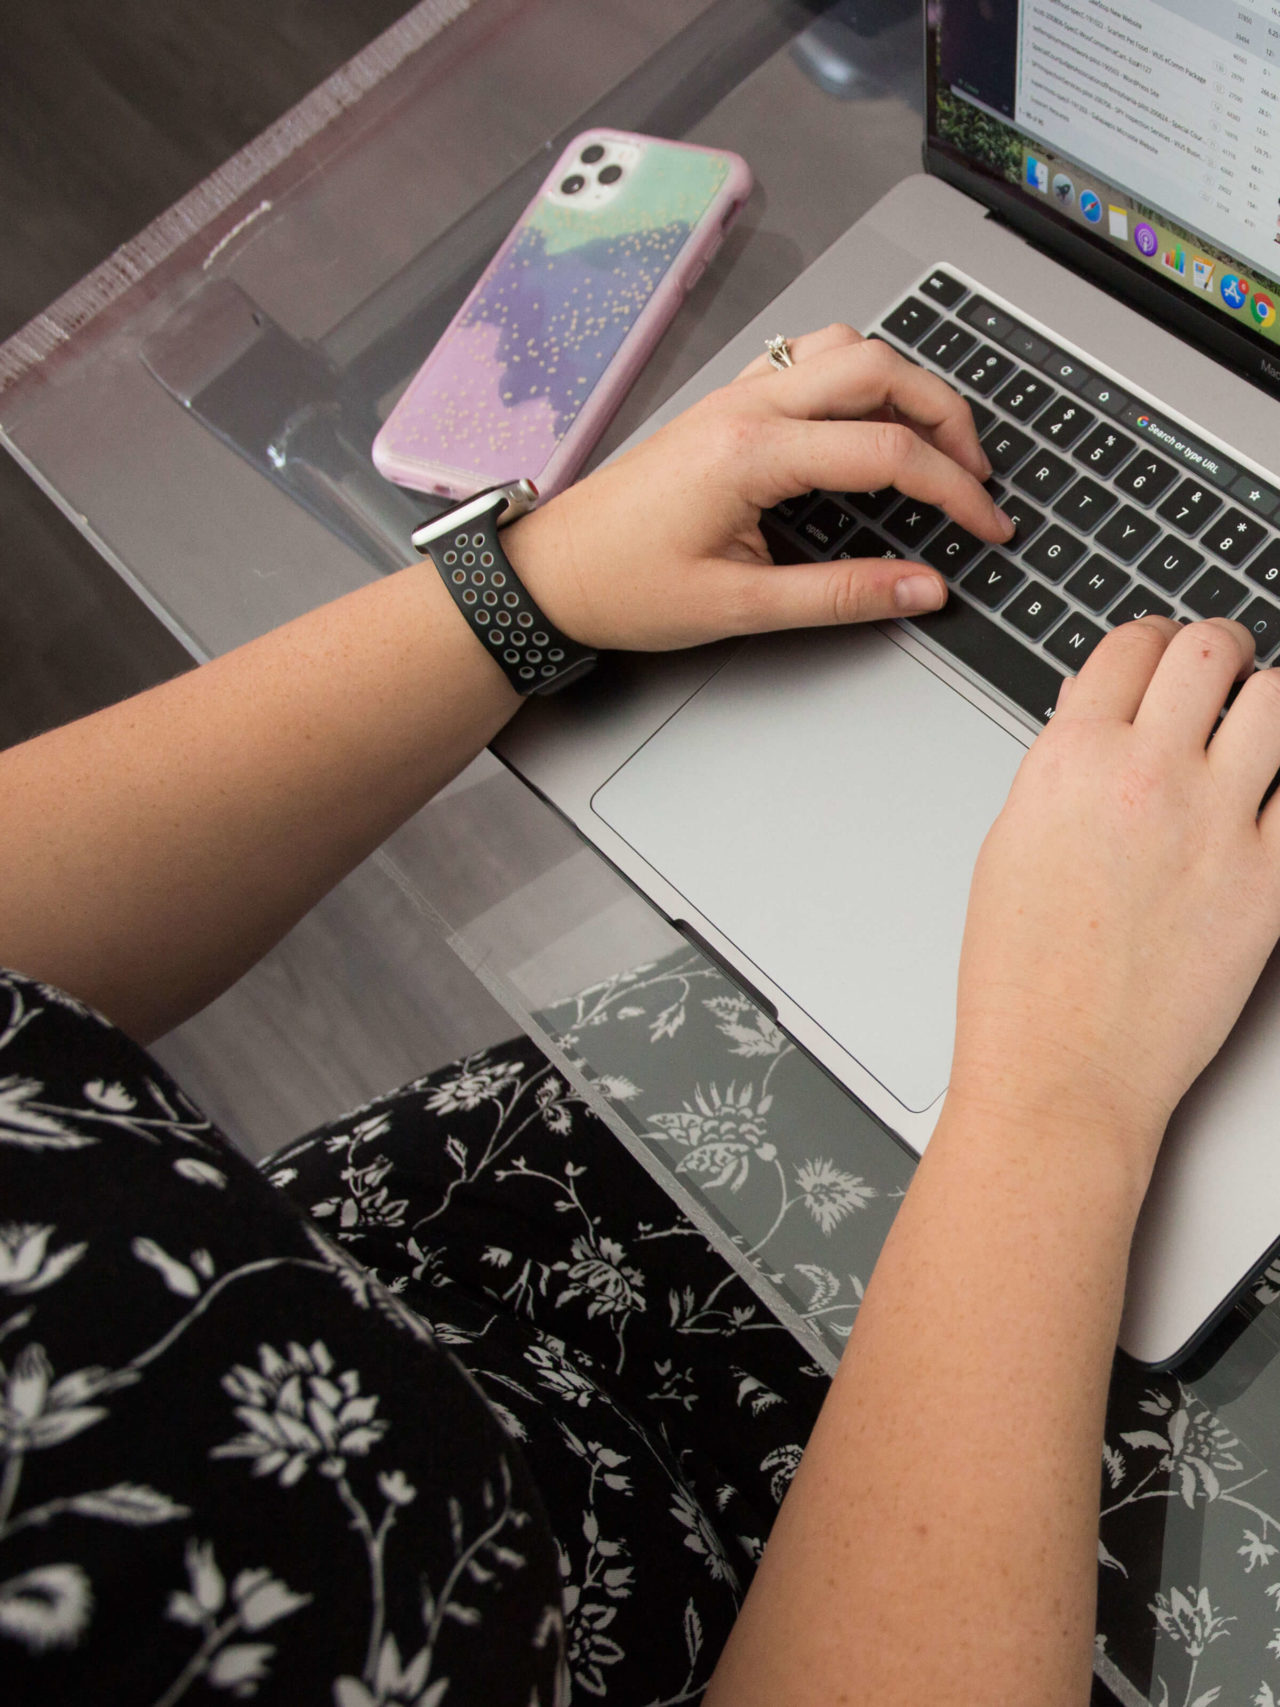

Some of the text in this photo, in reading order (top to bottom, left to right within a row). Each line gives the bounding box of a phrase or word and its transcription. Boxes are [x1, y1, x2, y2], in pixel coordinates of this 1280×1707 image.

[937, 345, 946, 354] 1
[987, 358, 996, 366] @
[972, 369, 984, 380] 2
[1011, 395, 1023, 405] 3
[1064, 410, 1075, 419] $
[1051, 424, 1062, 433] 4
[997, 440, 1010, 452] E
[1106, 436, 1115, 446] %
[1091, 448, 1103, 460] 5
[1148, 423, 1219, 474] Search or type URL
[1036, 468, 1049, 480] R
[1134, 476, 1145, 487] 6
[1080, 496, 1092, 507] T
[1192, 492, 1201, 502] &
[906, 512, 920, 525] X
[1177, 508, 1189, 518] 7
[806, 523, 828, 544] option
[1123, 525, 1135, 537] Y
[947, 543, 959, 554] C
[1220, 538, 1232, 549] 8
[1048, 545, 1061, 557] G
[1164, 556, 1178, 569] U
[988, 572, 1001, 583] V
[1266, 569, 1278, 579] 9
[1089, 575, 1104, 588] H
[1028, 602, 1041, 614] B
[1134, 609, 1147, 619] J
[1069, 633, 1084, 648] N
